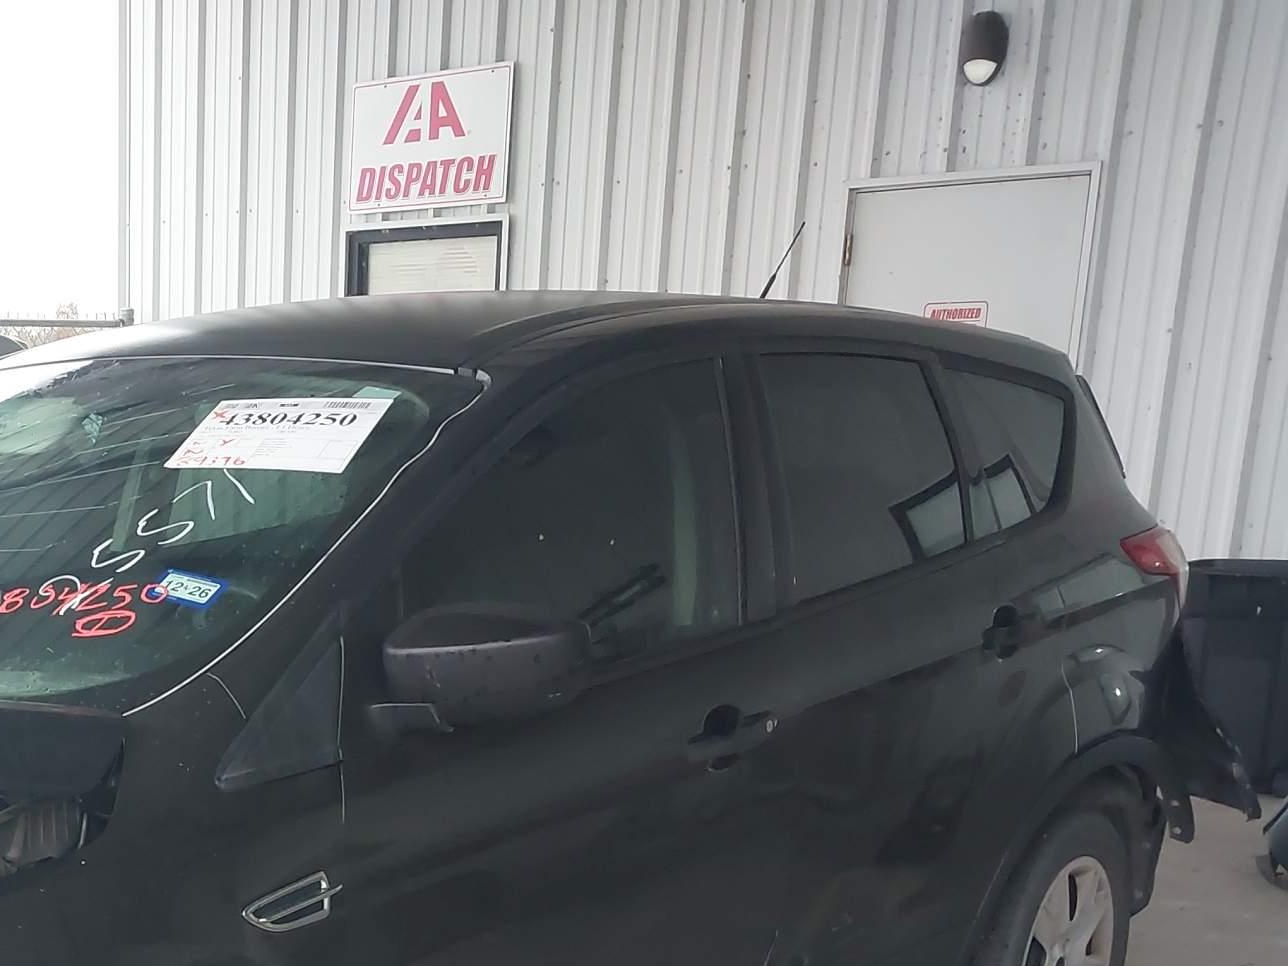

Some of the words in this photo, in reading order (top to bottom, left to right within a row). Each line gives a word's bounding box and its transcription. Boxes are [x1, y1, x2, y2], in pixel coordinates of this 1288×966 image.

[356, 154, 497, 203] DISPATCH
[930, 307, 982, 320] AUTHORIZED
[219, 410, 358, 426] 43804250
[186, 585, 212, 599] 26
